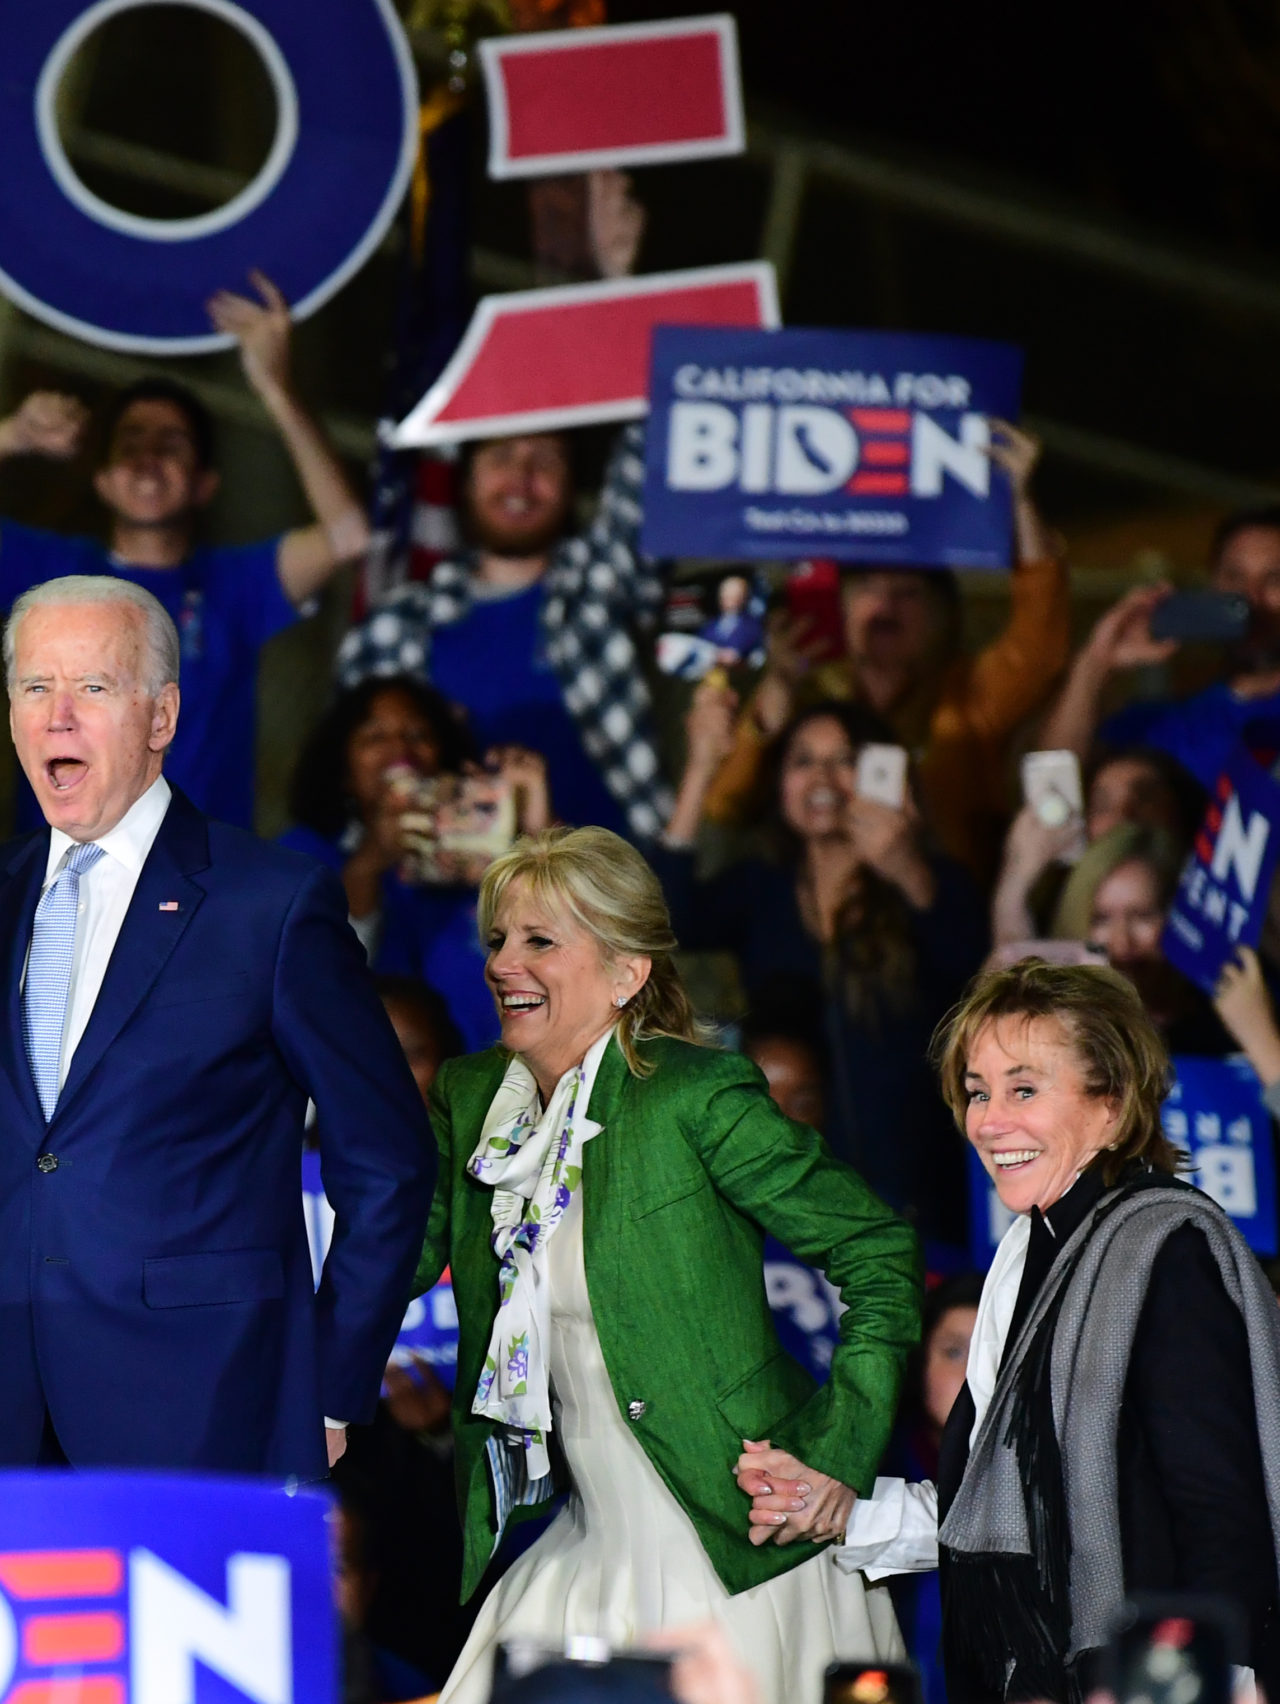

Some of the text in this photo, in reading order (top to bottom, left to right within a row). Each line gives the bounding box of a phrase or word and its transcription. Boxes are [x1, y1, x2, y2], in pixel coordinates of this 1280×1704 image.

[674, 364, 971, 409] CALIFORNIA FOR
[668, 400, 990, 498] BIDEN
